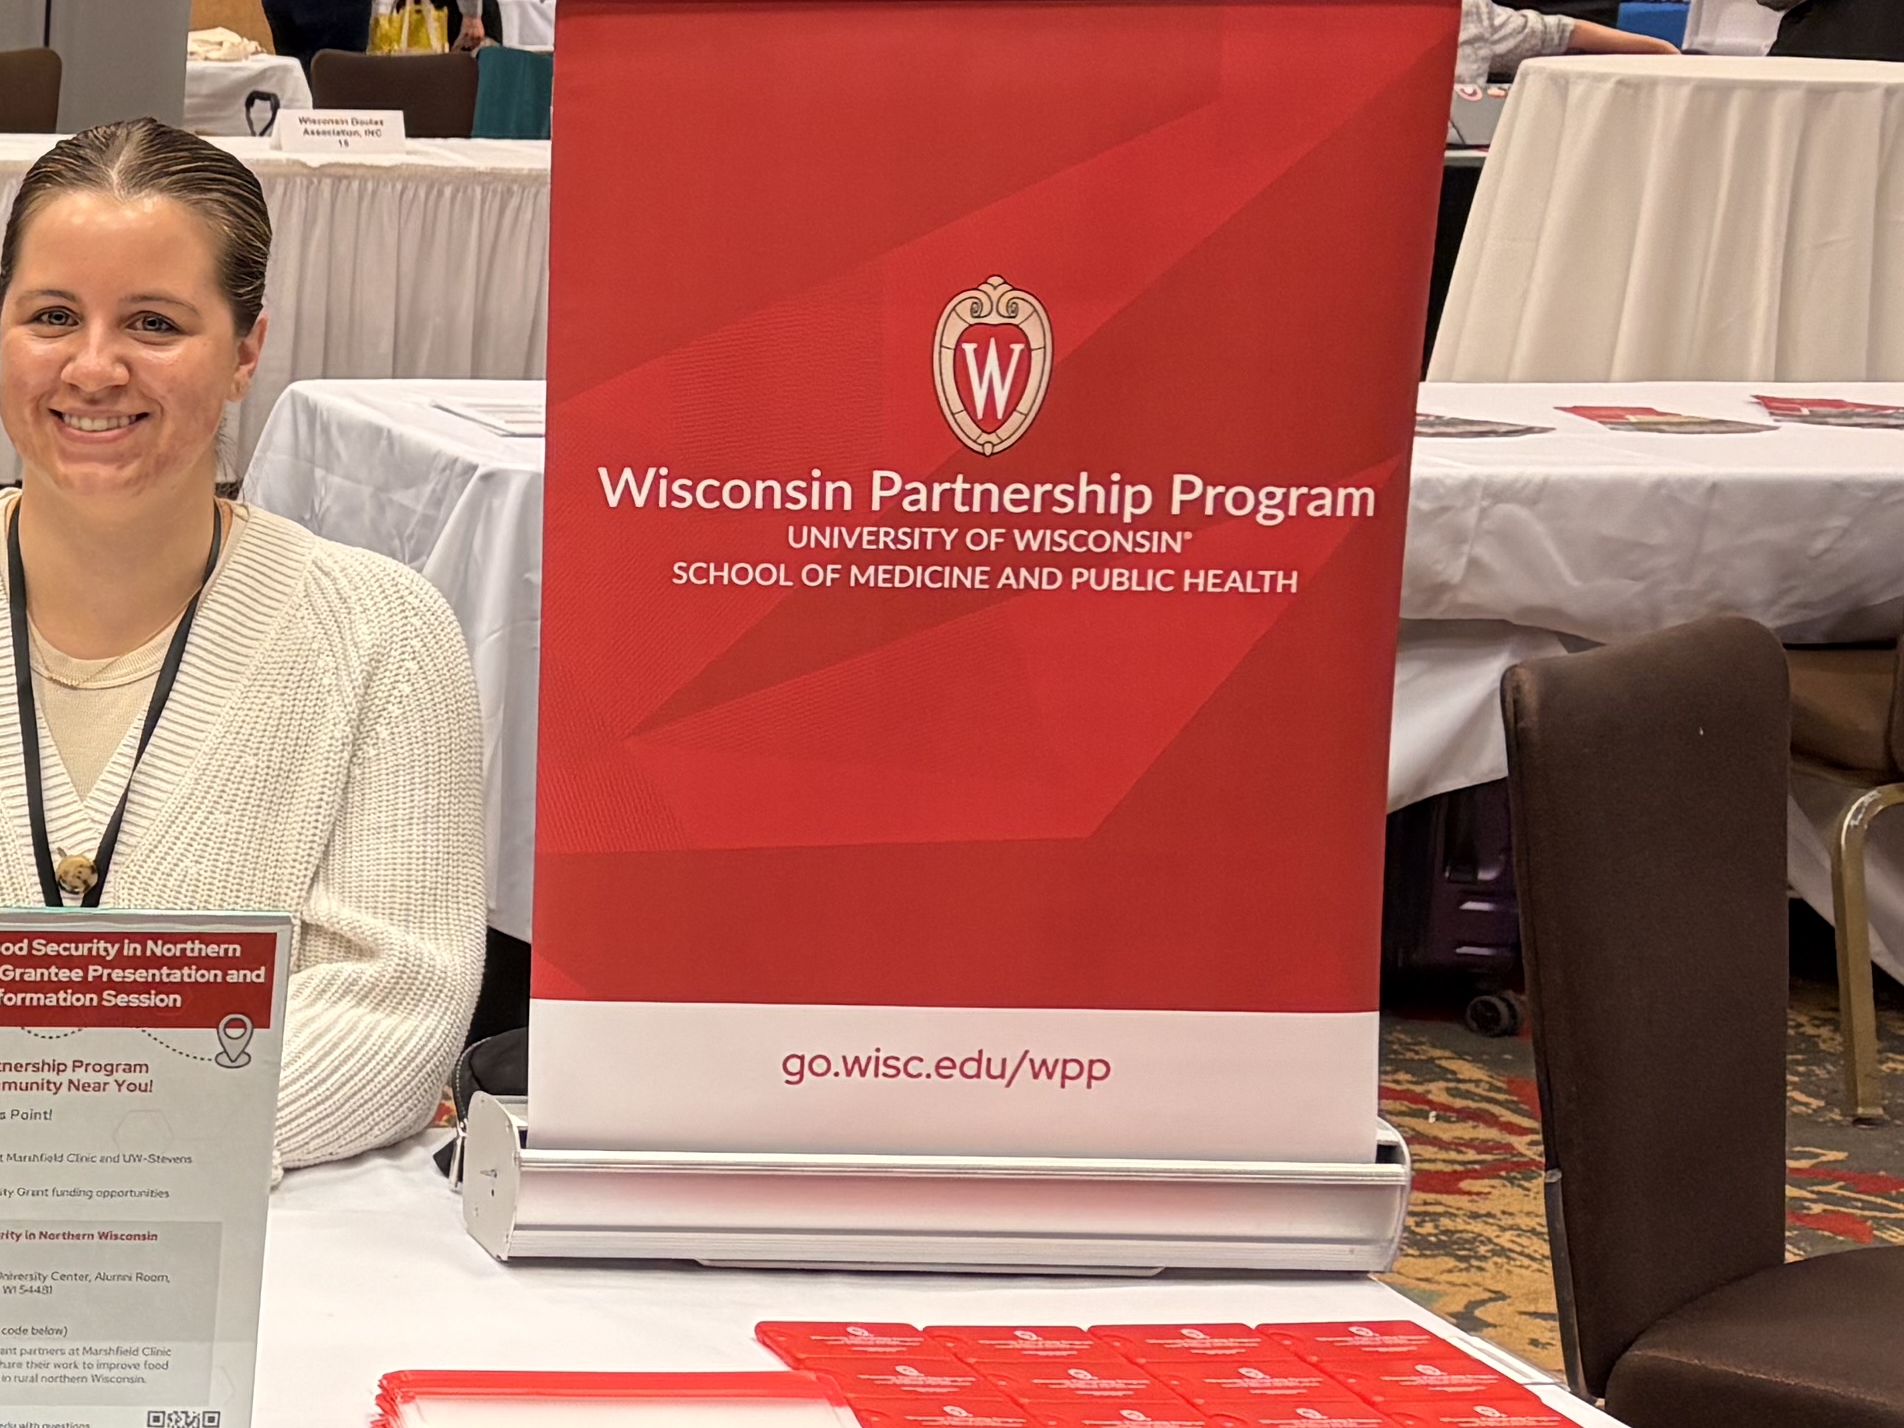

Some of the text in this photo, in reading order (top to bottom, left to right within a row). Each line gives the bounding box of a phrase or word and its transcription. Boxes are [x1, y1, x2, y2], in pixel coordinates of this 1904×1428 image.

[298, 116, 348, 126] Wisconsin
[303, 128, 362, 138] Association,
[961, 337, 1026, 421] W
[598, 467, 1374, 525] Wisconsin Partnership Program
[788, 526, 958, 550] UNIVERSITY
[965, 528, 1005, 550] OF
[672, 562, 1297, 592] SCHOOL OF MEDICINE AND PUBLIC HEALTH
[32, 939, 120, 960] Security
[123, 939, 141, 955] in
[146, 940, 240, 956] Northern
[88, 965, 222, 982] Presentation
[226, 966, 265, 982] and
[102, 990, 181, 1006] Session
[72, 1059, 148, 1076] Program
[782, 1047, 1110, 1089] go.wisc.edu/wpp
[68, 1078, 109, 1092] Near
[114, 1079, 152, 1092] You!
